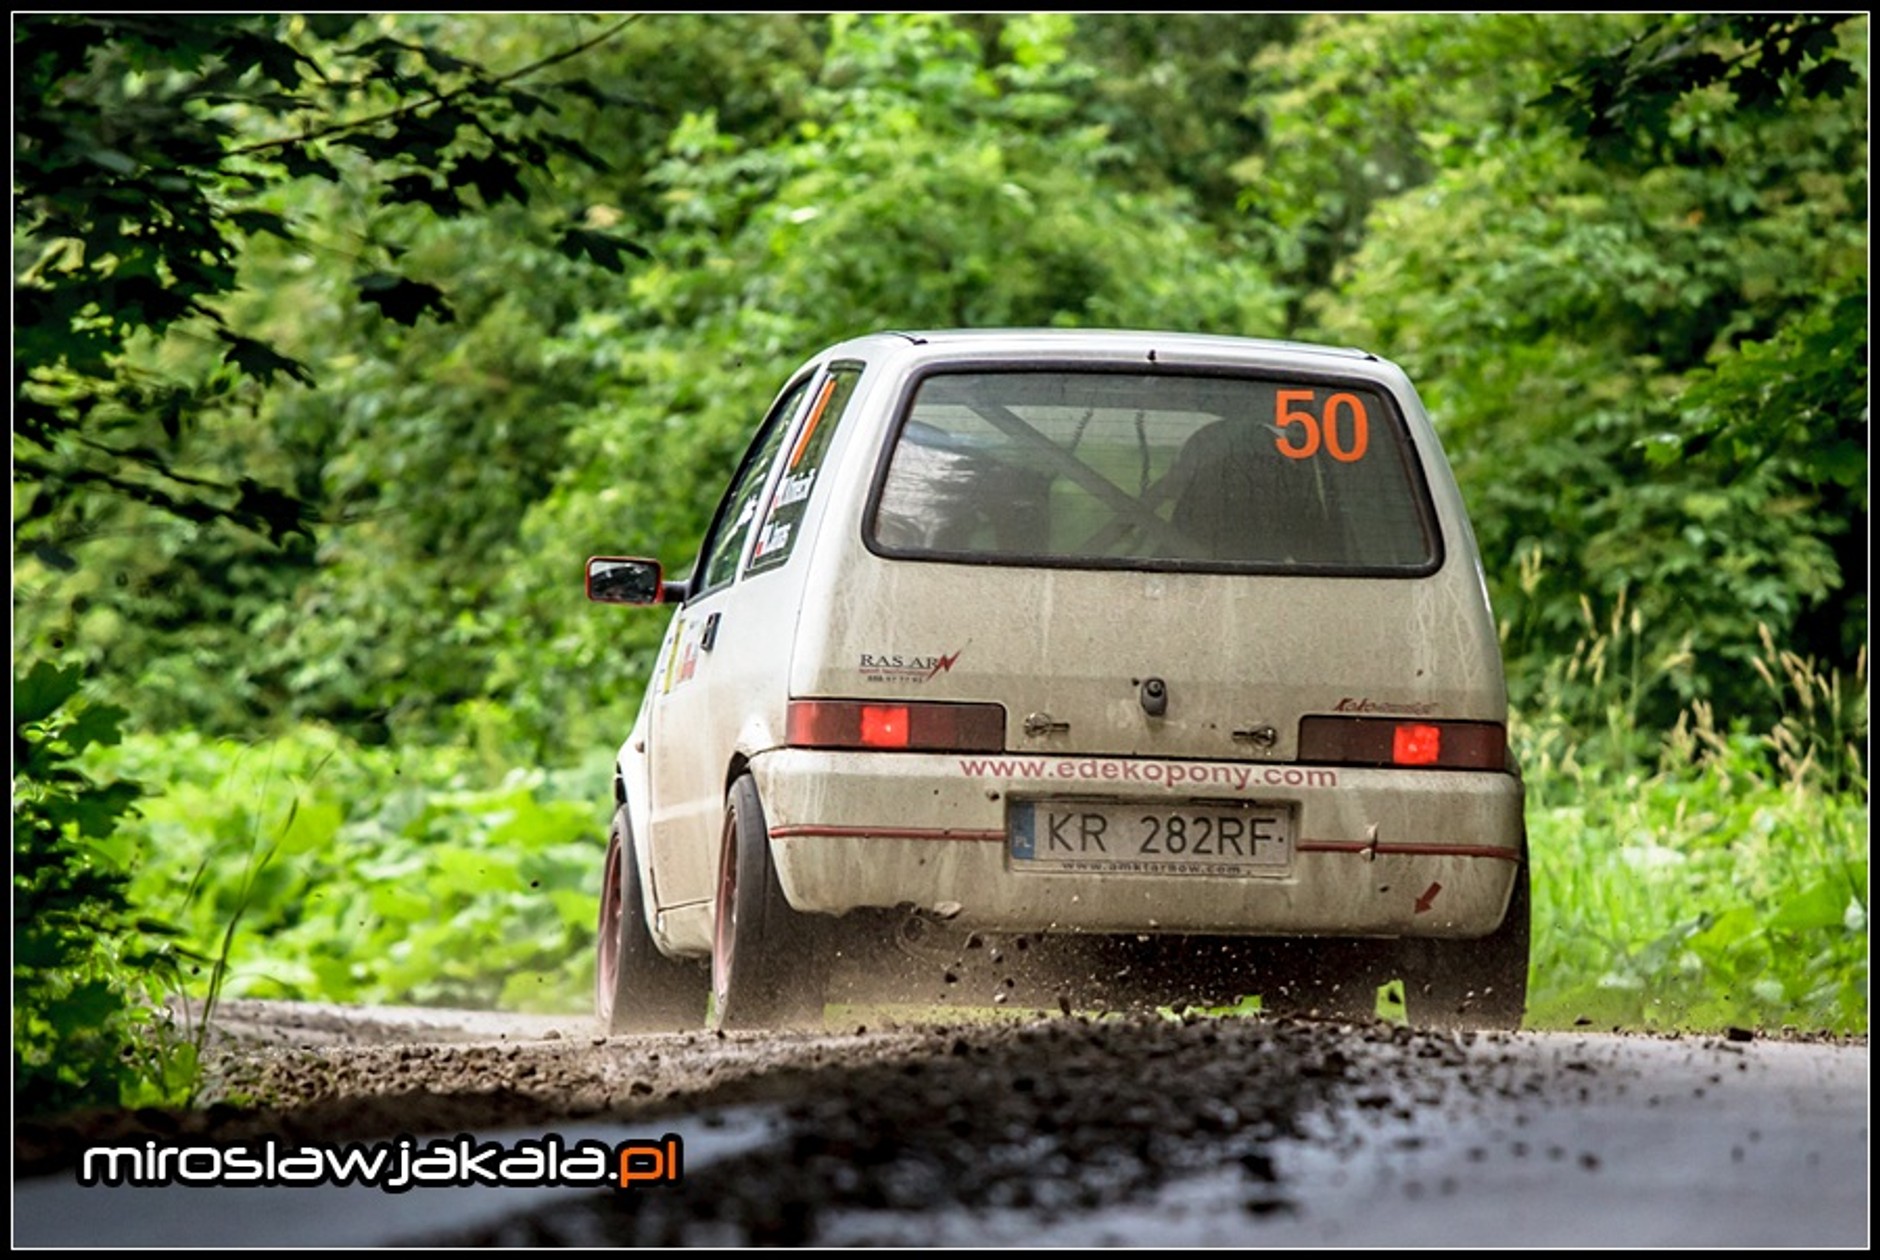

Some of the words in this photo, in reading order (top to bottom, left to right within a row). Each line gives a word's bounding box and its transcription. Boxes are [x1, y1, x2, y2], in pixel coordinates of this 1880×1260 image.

[1276, 389, 1368, 463] 50
[860, 654, 904, 668] RAS
[960, 758, 1337, 789] www.edekopony.com
[1048, 813, 1107, 852] KR
[1140, 815, 1277, 856] 282RF
